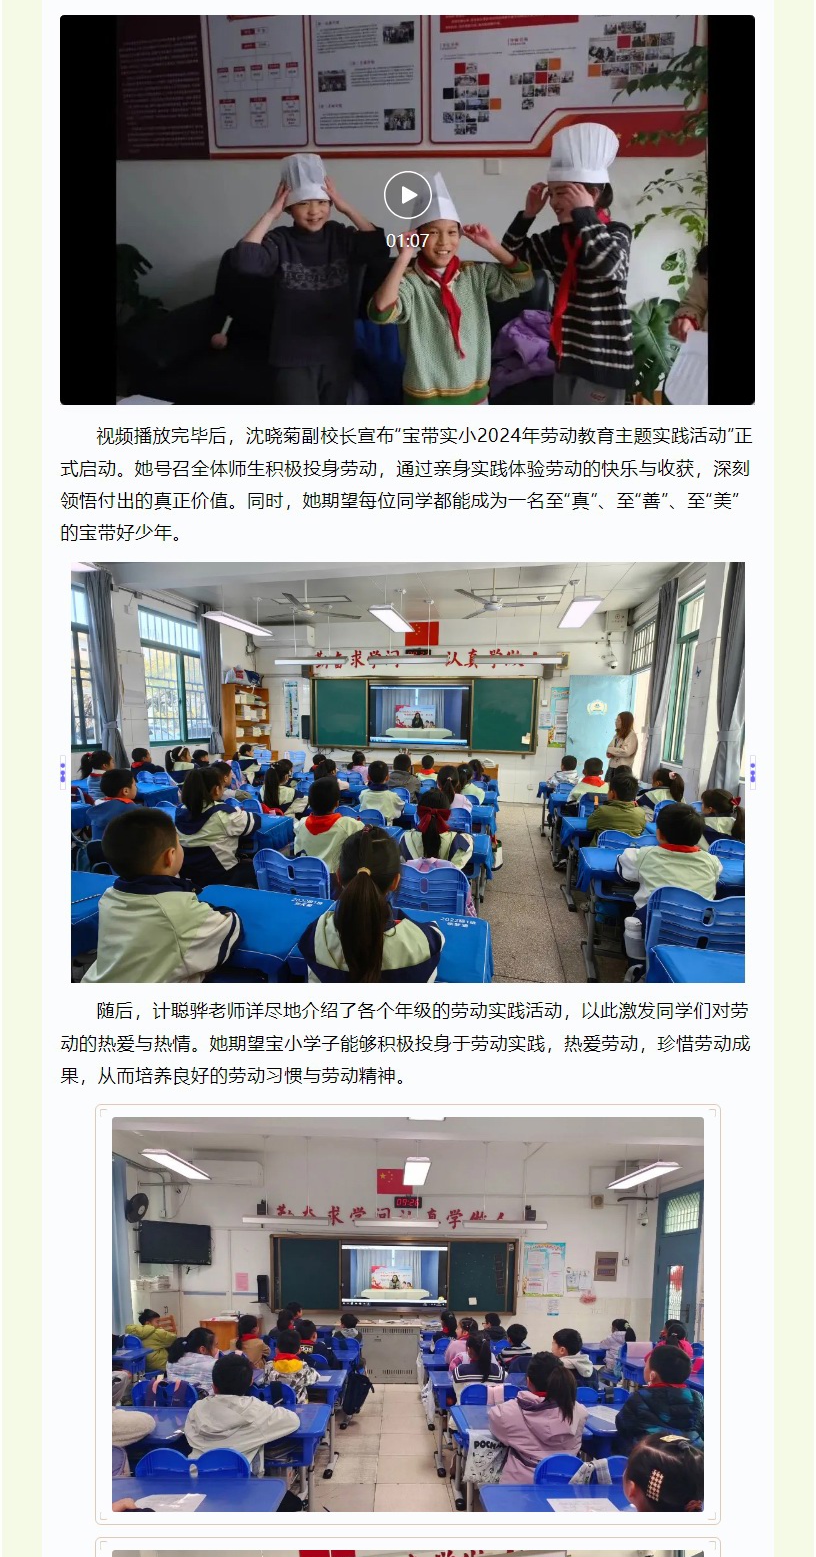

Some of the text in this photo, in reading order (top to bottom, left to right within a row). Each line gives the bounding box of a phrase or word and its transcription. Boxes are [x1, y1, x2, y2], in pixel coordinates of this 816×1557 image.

[60, 458, 750, 479] 式启动。她号召全体师生积极投身劳动，通过亲身实践体验劳动的快乐与收获，深刻
[61, 523, 183, 542] 的宝带好少年。
[97, 1001, 749, 1021] 随后，计聪骅老师详尽地介绍了各个年级的劳动实践活动，以此激发同学们对劳
[60, 1033, 751, 1054] 动的热爱与热情。她期望宝小学子能够积极投身于劳动实践，热爱劳动，珍惜劳动成
[60, 1066, 405, 1086] 果，从而培养良好的劳动习惯与劳动精神。
